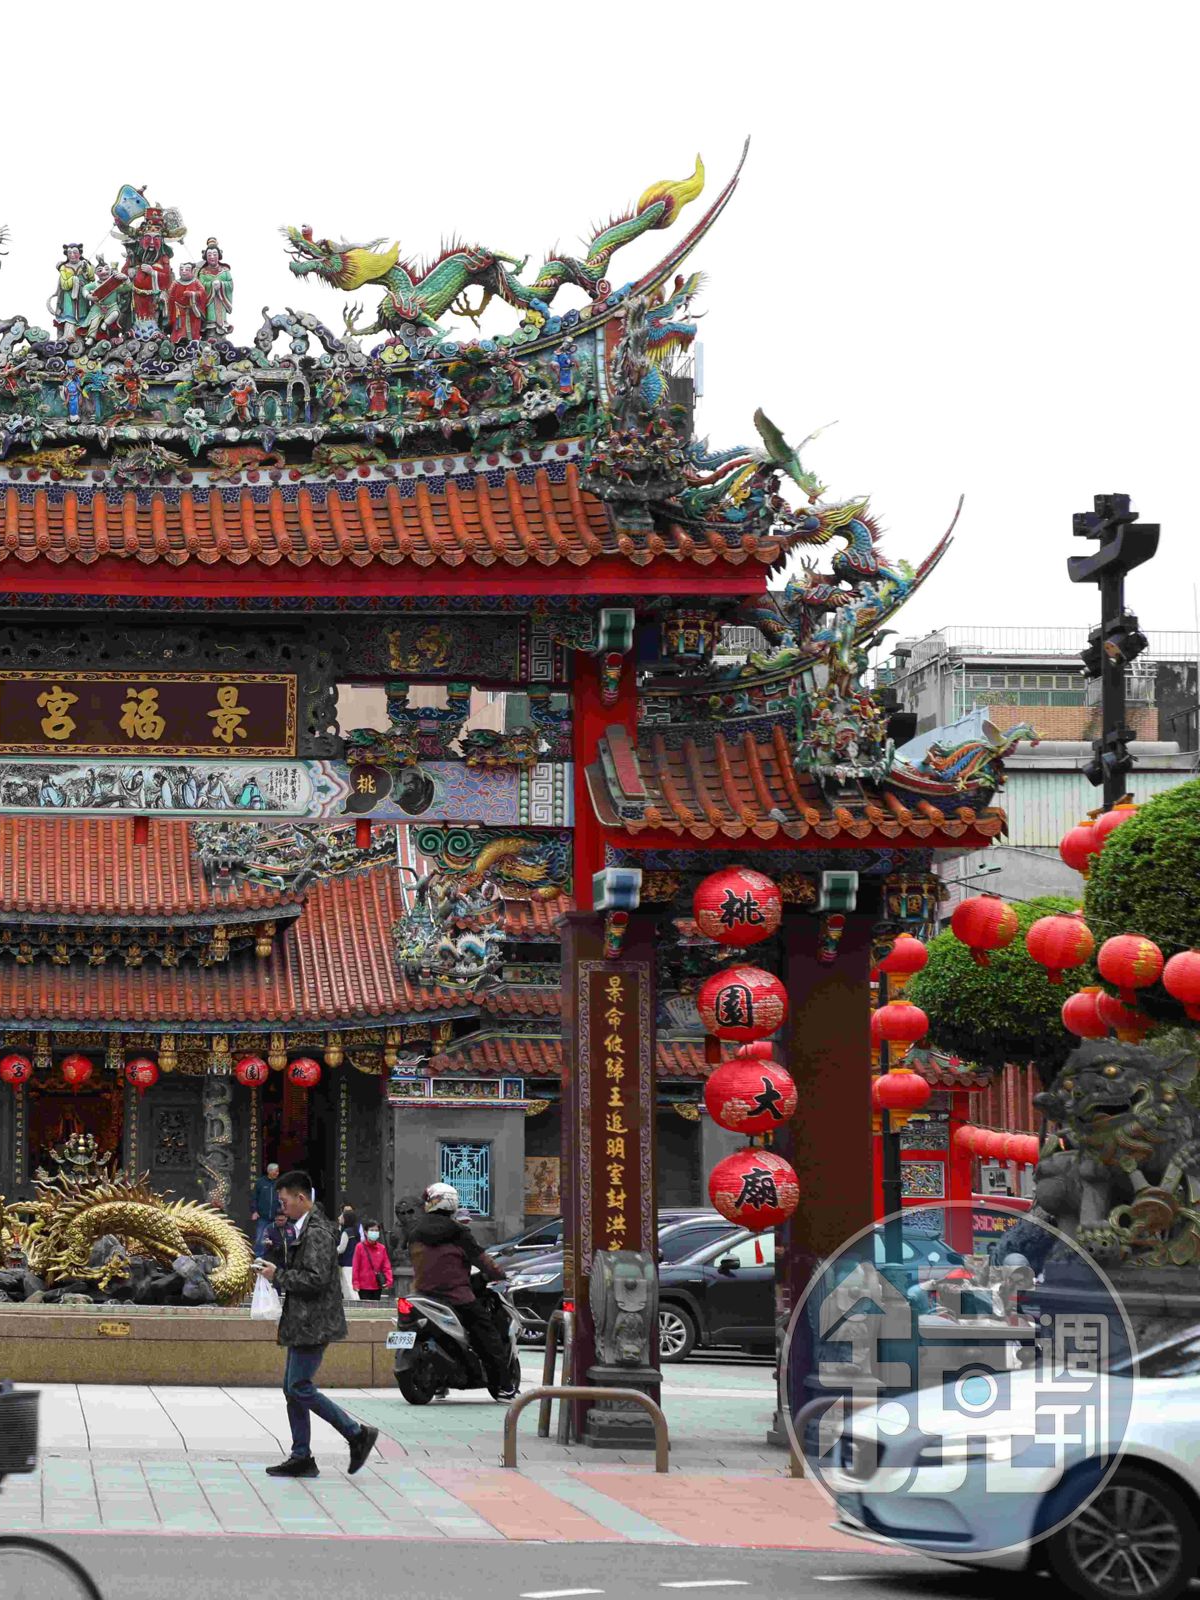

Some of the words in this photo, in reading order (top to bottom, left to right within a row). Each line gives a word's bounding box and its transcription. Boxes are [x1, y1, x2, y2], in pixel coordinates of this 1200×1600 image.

[37, 685, 251, 744] 景福宮
[356, 774, 377, 794] 桃
